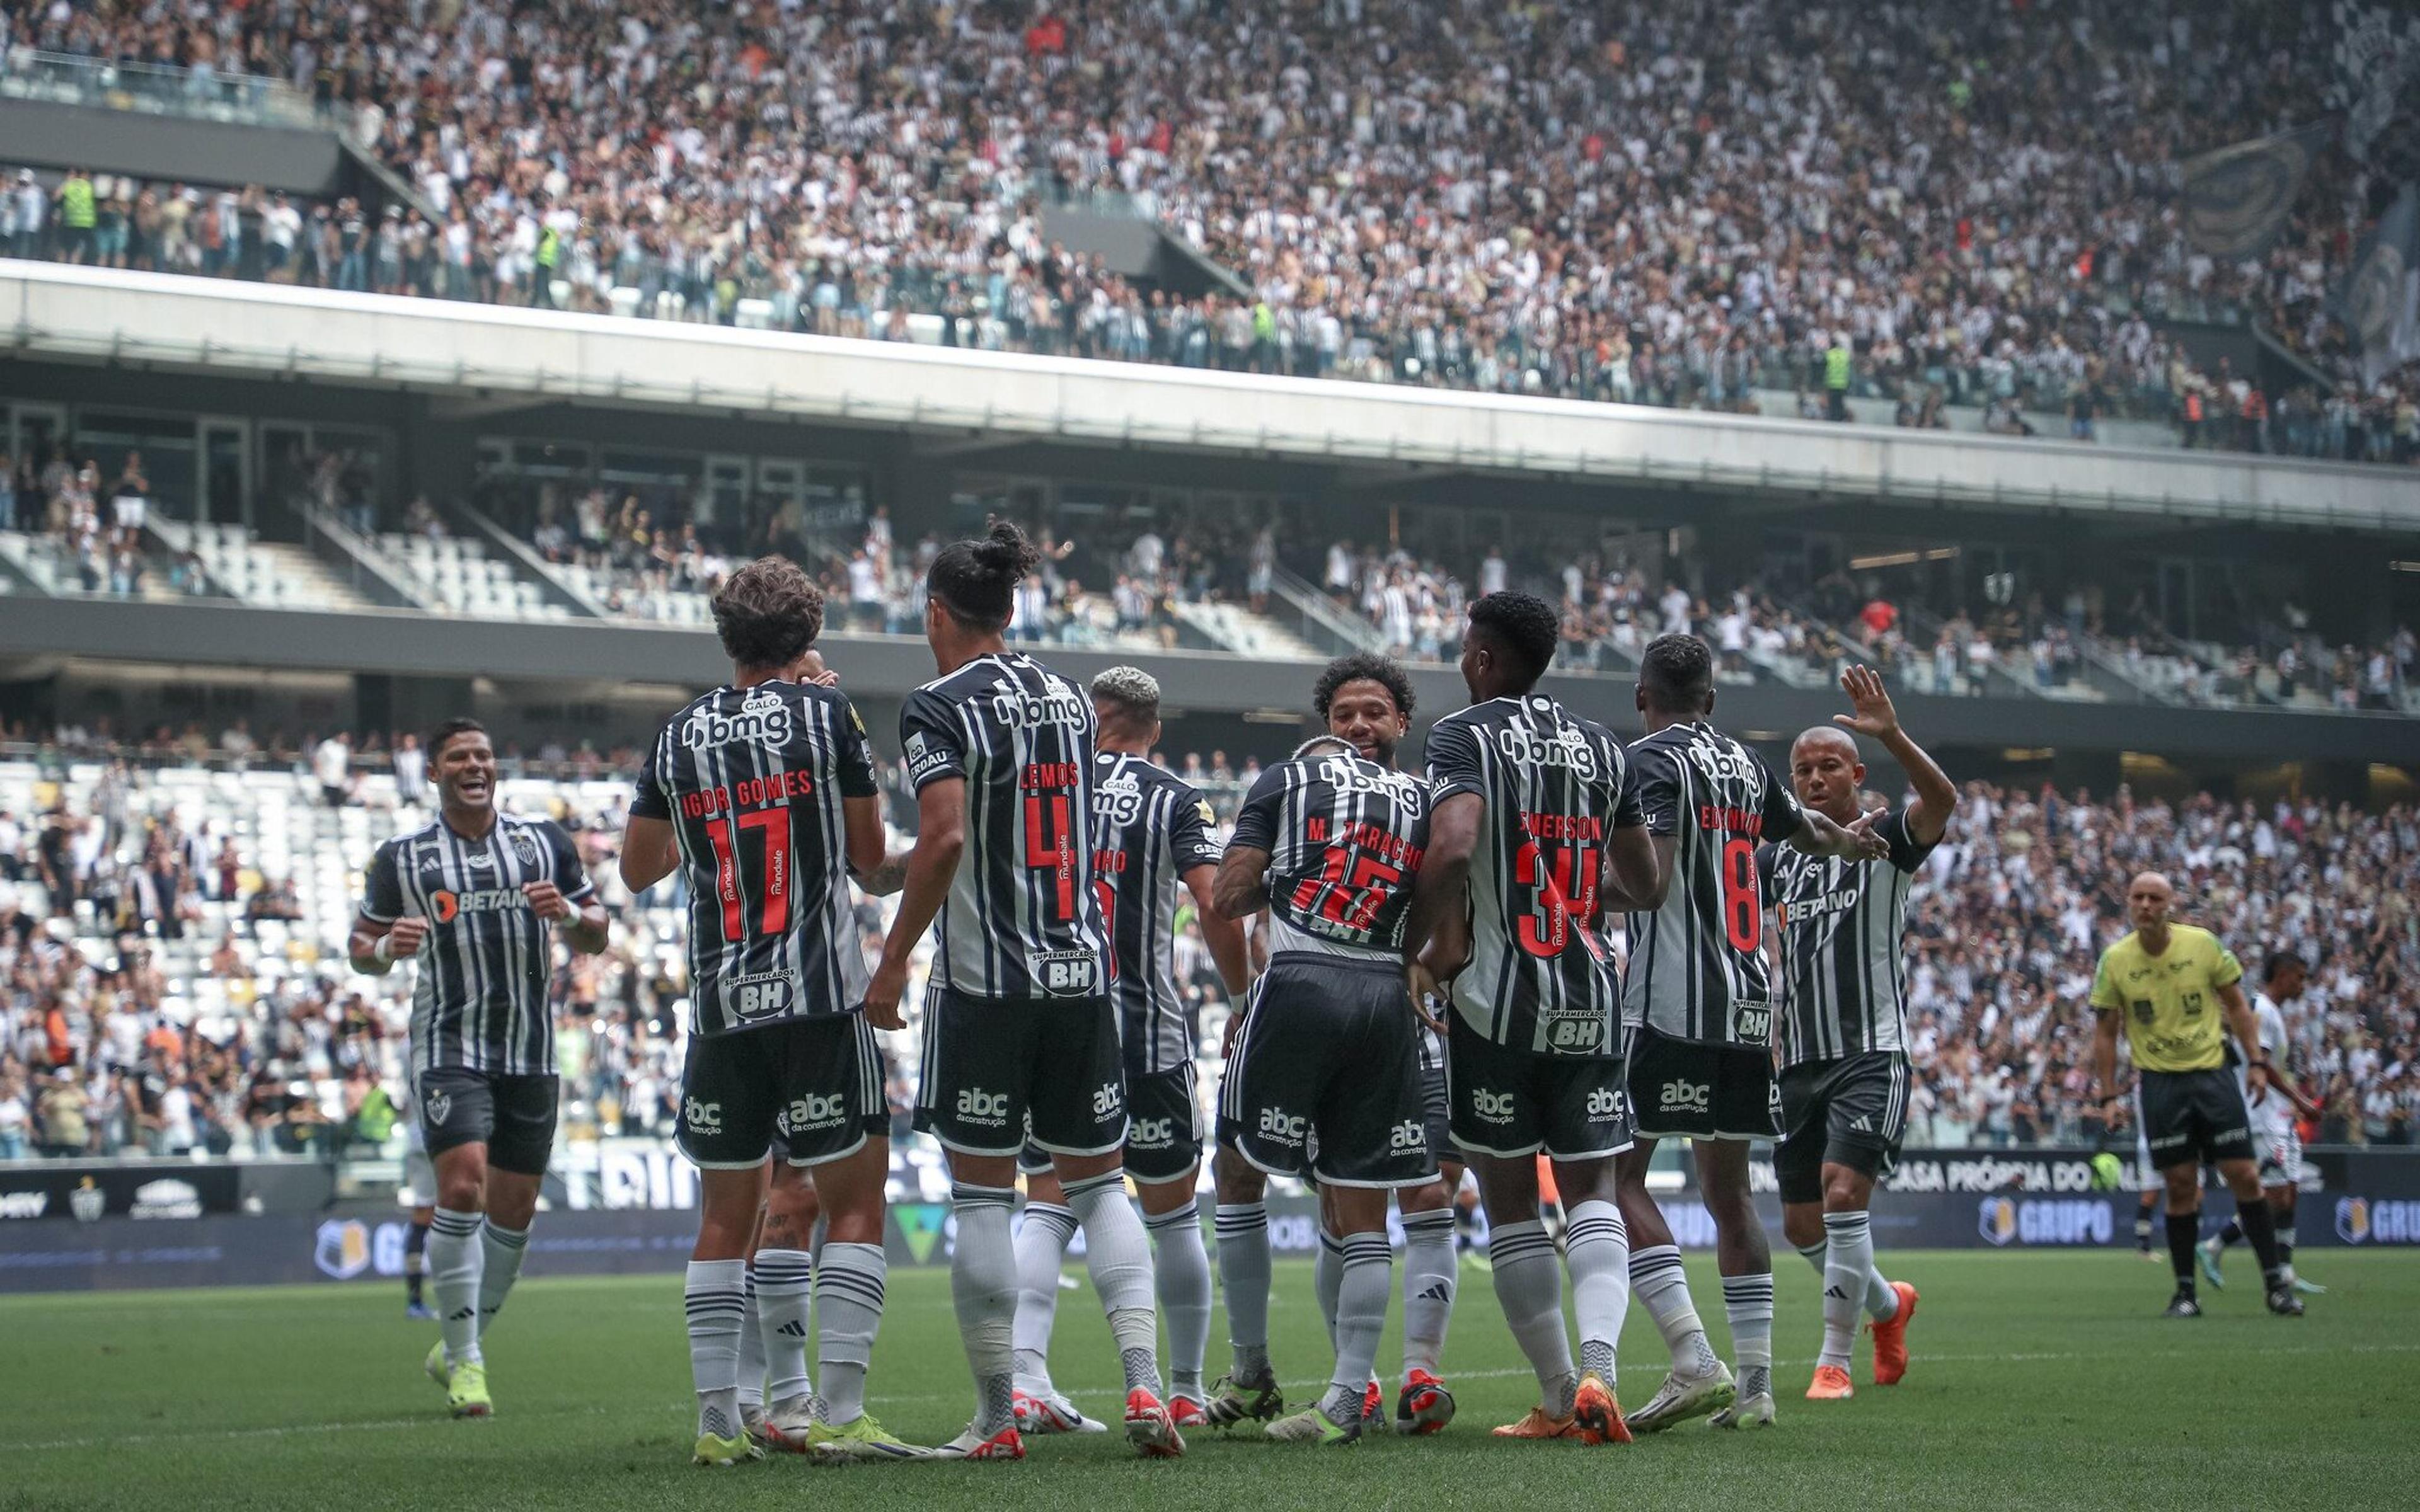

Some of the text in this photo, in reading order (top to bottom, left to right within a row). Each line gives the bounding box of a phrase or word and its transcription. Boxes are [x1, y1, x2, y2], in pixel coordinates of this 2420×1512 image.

[744, 697, 779, 711] GALO
[1019, 694, 1085, 731] bmg
[708, 709, 790, 743] bmg
[1562, 735, 1582, 743] ALO
[911, 751, 947, 779] ERDAU
[1526, 733, 1594, 778] bmg
[1020, 762, 1078, 790] LEMOS
[1105, 782, 1135, 791] GALO
[682, 769, 813, 820] IGOR GOMES
[1093, 791, 1138, 823] mg
[1308, 816, 1331, 842] M.
[1025, 796, 1075, 919] 4
[706, 806, 790, 942] 17
[724, 857, 735, 902] mundiale
[771, 850, 783, 896] mundiale
[458, 888, 529, 912] BETAN
[1516, 840, 1605, 961] 34
[1579, 885, 1594, 928] mundiale
[1724, 839, 1760, 953] 8
[1787, 889, 1857, 923] BETANO
[1552, 902, 1564, 947] mundiale
[1033, 950, 1098, 961] SUPERMERCADOS
[725, 969, 795, 987] SUPERMERCADOS
[1049, 962, 1091, 988] BH
[740, 982, 784, 1014] BH
[1545, 1009, 1608, 1017] SUPERMERCADOS
[1739, 1010, 1770, 1036] BH
[1554, 1021, 1599, 1046] BH
[957, 1087, 1008, 1117] abc
[1473, 1087, 1514, 1115] abc
[1587, 1087, 1623, 1114] abc
[1661, 1078, 1710, 1106] abc
[790, 1093, 843, 1123] abc
[957, 1113, 1006, 1128] da construção
[1260, 1106, 1305, 1138] abc
[1670, 1103, 1708, 1113] construção
[792, 1116, 846, 1132] da construção
[1128, 1118, 1172, 1142] abc
[1390, 1120, 1426, 1148] ab
[1265, 1133, 1303, 1147] construção
[1390, 1148, 1400, 1157] da
[1888, 1161, 1945, 1192] ASA
[2052, 1161, 2092, 1192] DO
[2019, 1200, 2113, 1243] GRUPO
